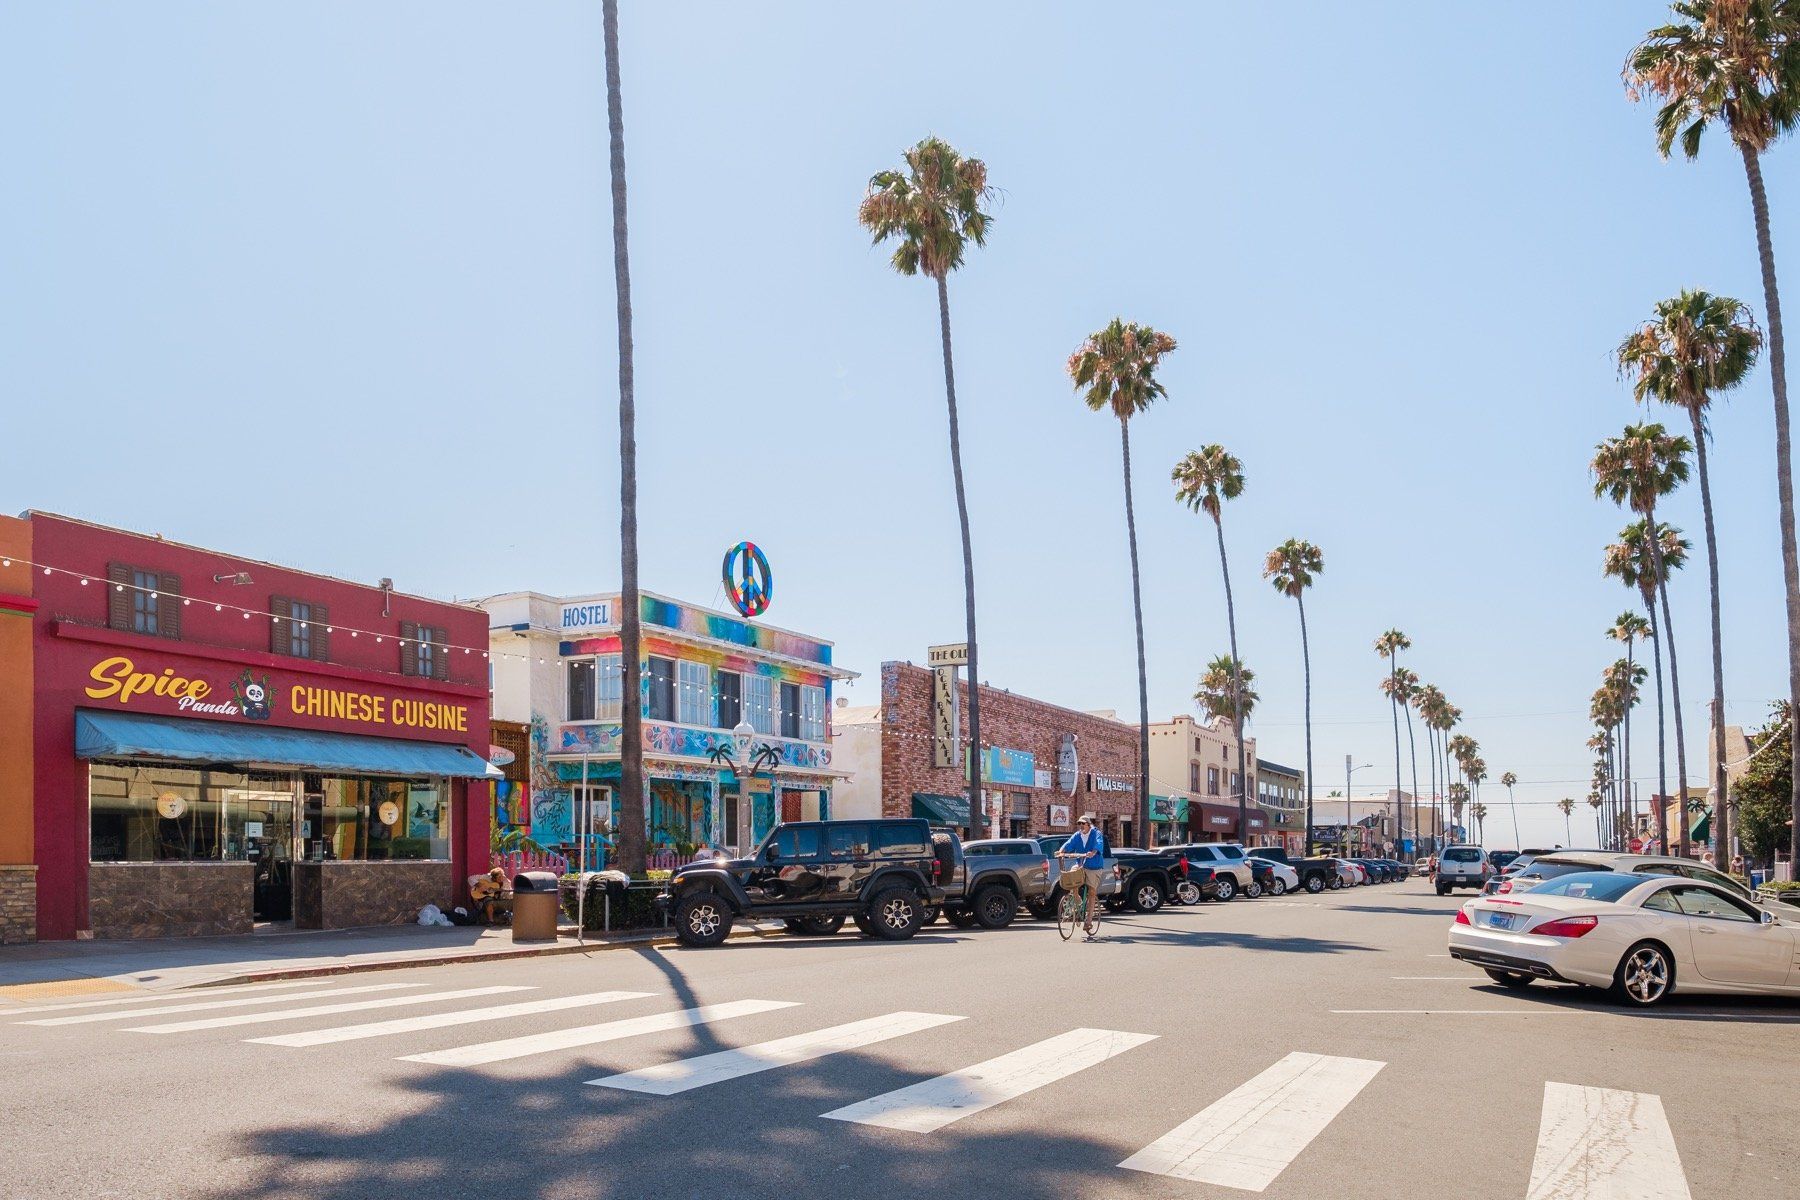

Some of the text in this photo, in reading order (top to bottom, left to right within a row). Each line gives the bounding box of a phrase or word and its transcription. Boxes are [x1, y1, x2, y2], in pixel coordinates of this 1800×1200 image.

[563, 605, 608, 627] HOSTEL
[930, 651, 948, 661] THE
[84, 656, 212, 703] Spice
[937, 668, 952, 706] OCEAN
[178, 696, 239, 716] Panda
[291, 685, 468, 732] CHINESE CUISINE
[937, 701, 952, 740] BEACH
